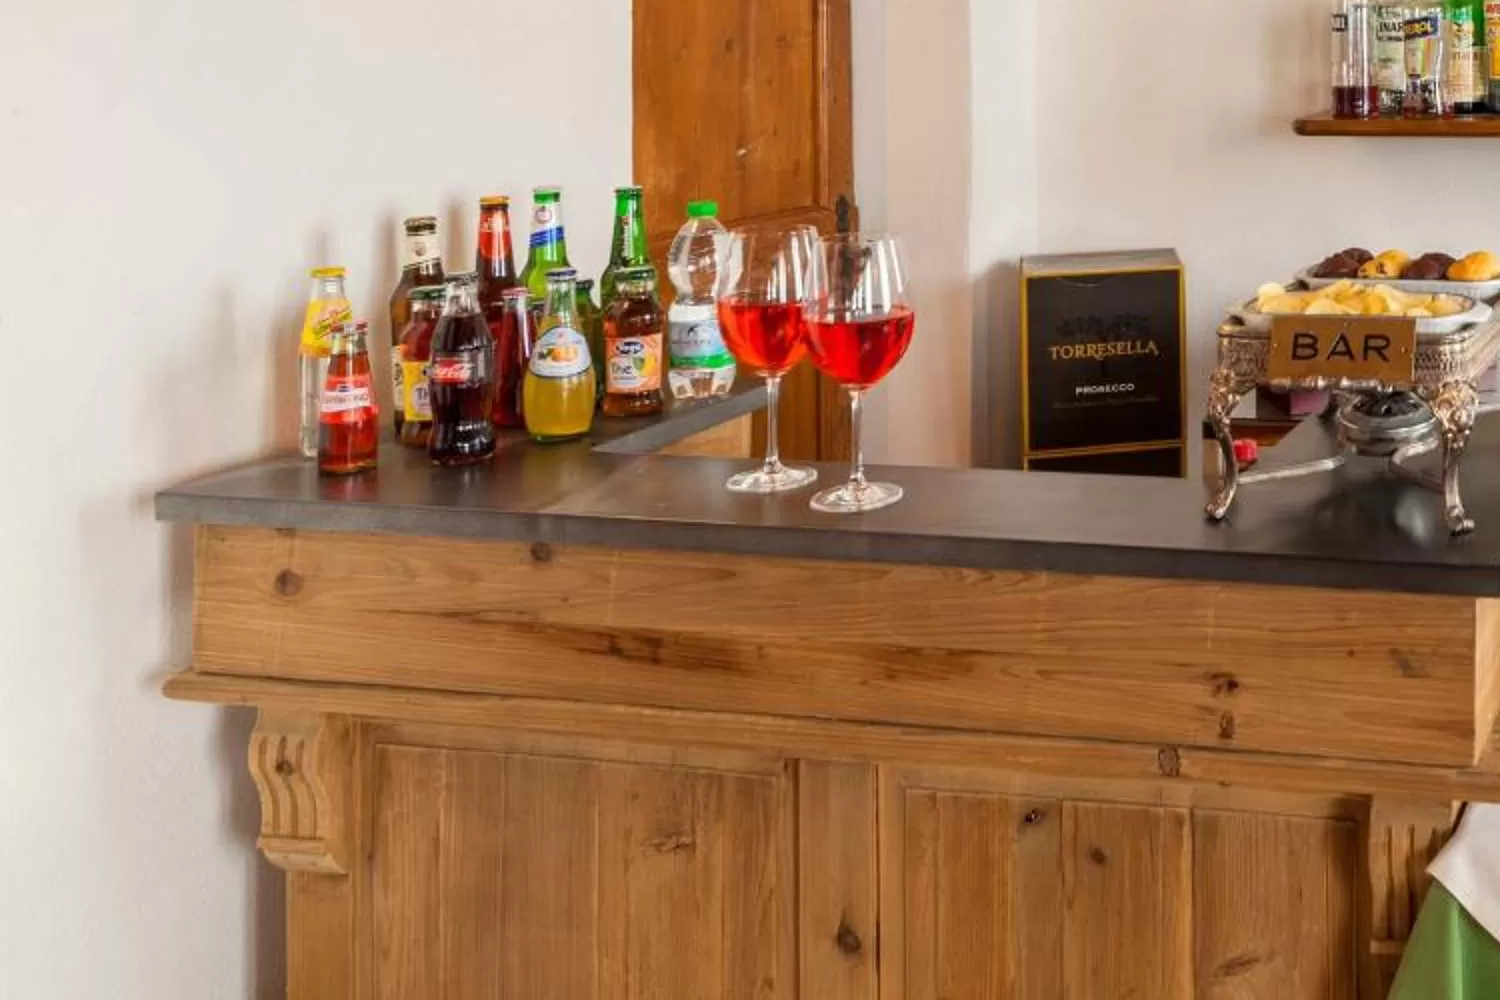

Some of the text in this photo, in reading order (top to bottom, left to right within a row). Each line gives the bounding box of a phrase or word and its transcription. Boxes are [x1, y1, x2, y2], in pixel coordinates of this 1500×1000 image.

[1047, 340, 1160, 361] TORRESELLA
[1291, 332, 1391, 362] BAR
[1075, 383, 1135, 397] PROSECCO
